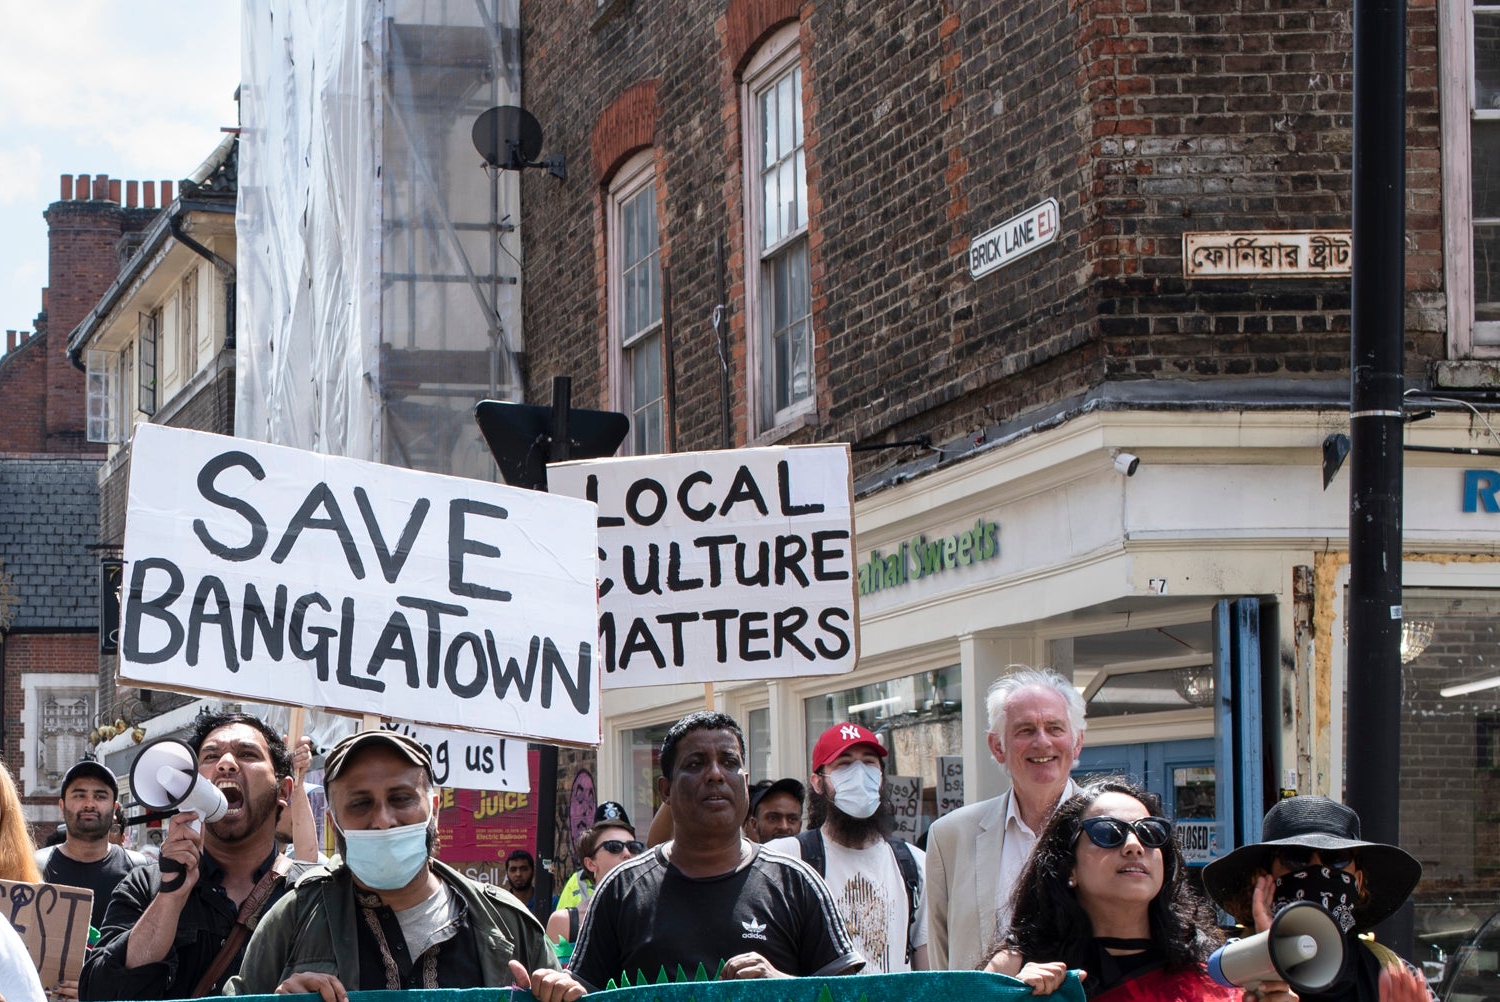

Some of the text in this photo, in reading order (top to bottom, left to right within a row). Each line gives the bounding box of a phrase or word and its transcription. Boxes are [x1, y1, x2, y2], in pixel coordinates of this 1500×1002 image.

[972, 235, 1001, 271] BRICK
[1004, 217, 1035, 254] LANE
[586, 460, 825, 527] LOCAL
[192, 450, 512, 602] SAVE
[858, 518, 997, 597] ahal Sweets
[122, 556, 592, 715] BANGLATOWN
[465, 738, 508, 786] us!
[465, 867, 498, 886] Sell
[741, 932, 767, 941] adidas
